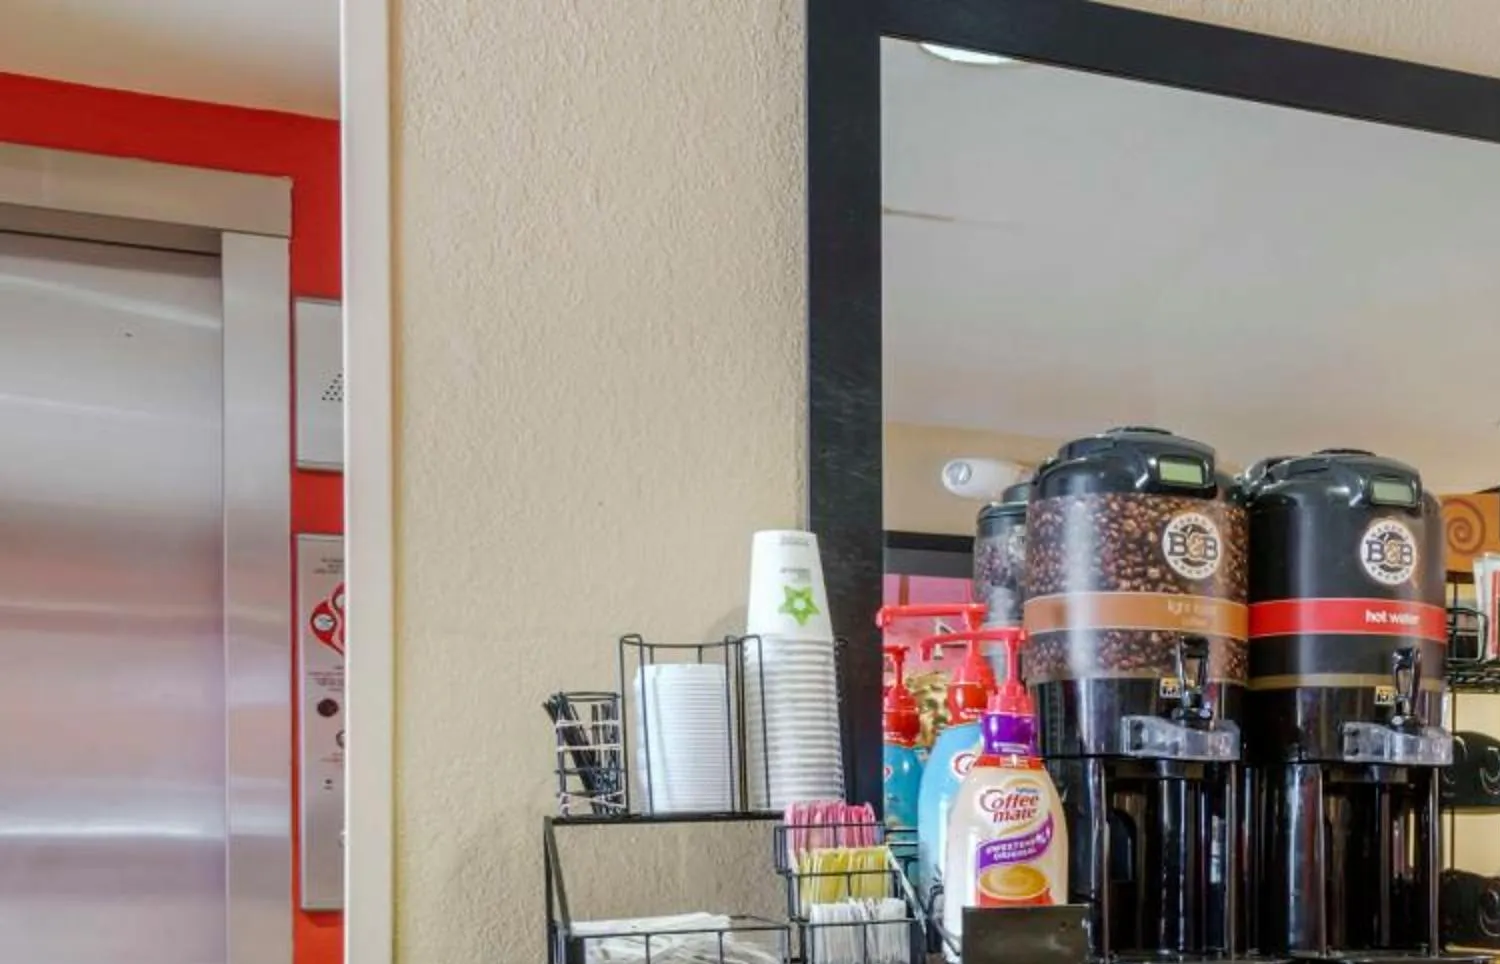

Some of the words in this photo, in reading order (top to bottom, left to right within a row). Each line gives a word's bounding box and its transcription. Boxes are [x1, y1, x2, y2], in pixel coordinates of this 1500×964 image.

[1167, 531, 1218, 561] B&B
[1366, 540, 1413, 566] B&B
[1365, 609, 1387, 624] hot
[1389, 612, 1420, 626] water
[980, 789, 1039, 813] Coffee
[993, 808, 1037, 824] mate
